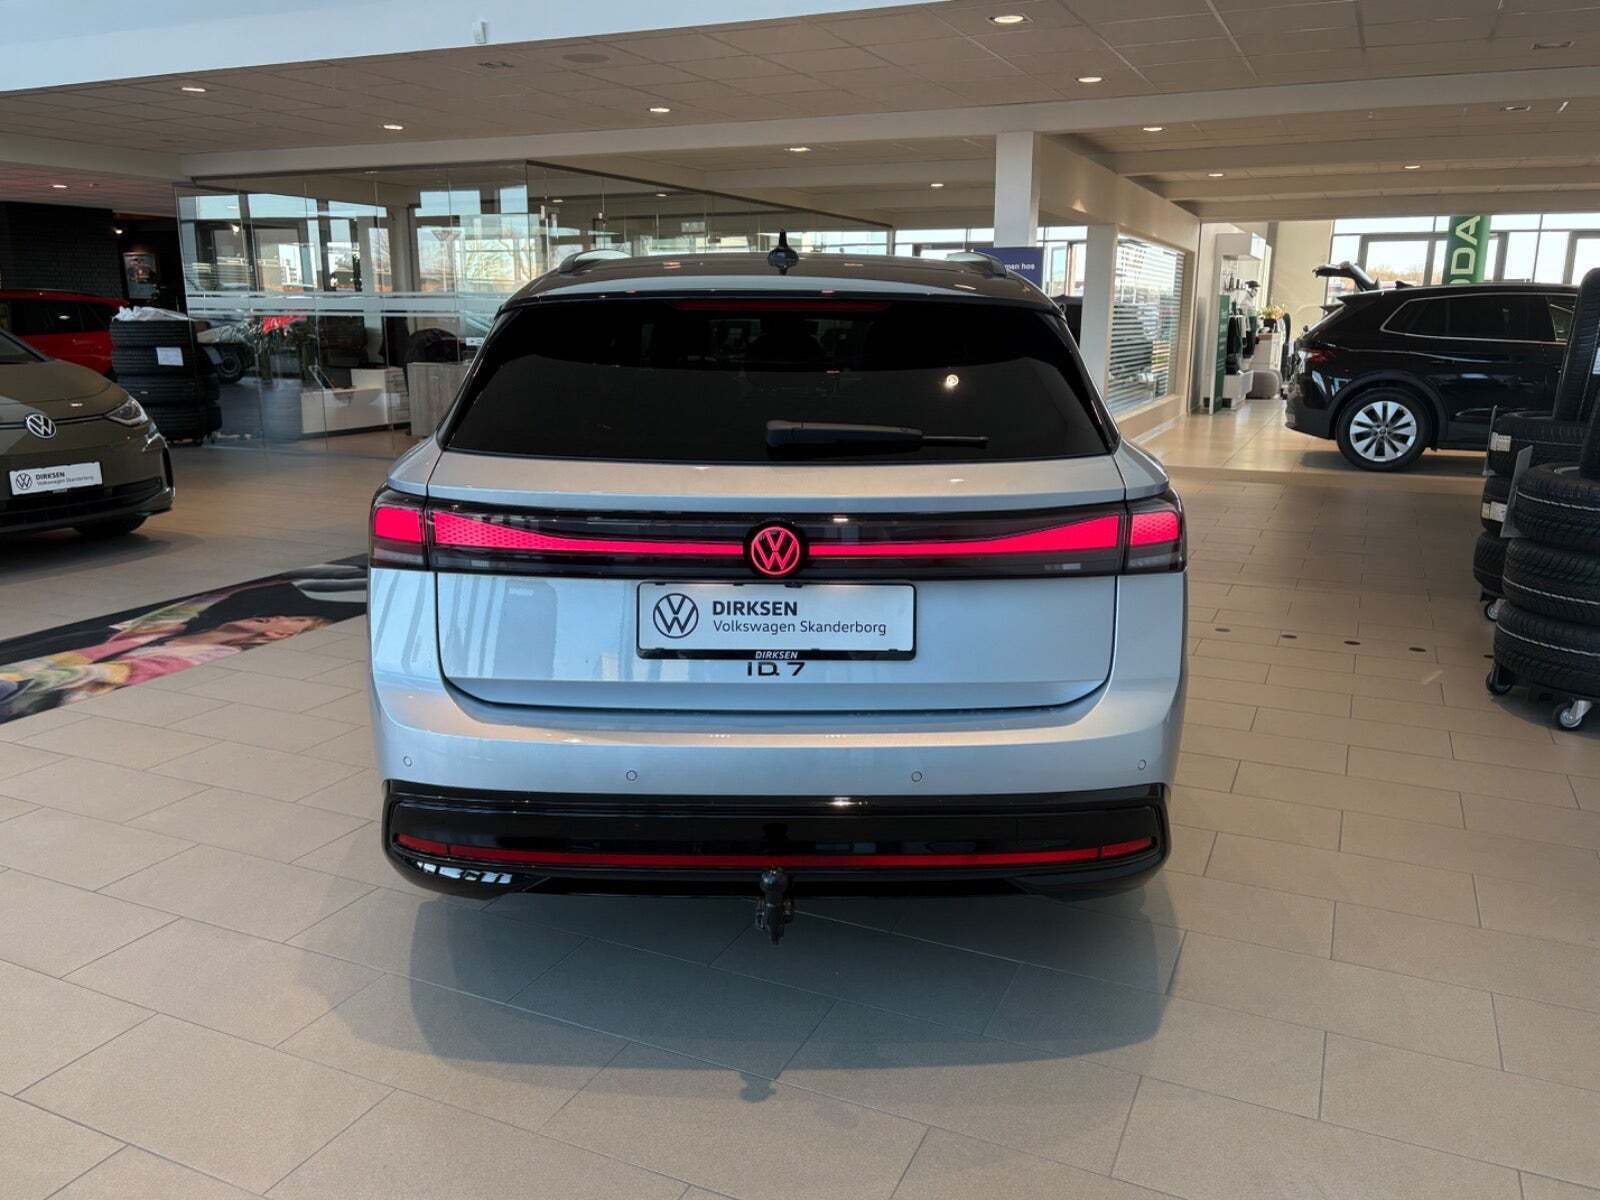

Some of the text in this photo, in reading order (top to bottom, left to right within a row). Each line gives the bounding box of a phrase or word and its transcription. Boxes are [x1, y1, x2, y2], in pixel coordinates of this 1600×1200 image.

[36, 471, 66, 480] DIRKSEN
[712, 600, 798, 617] DIRKSEN
[713, 619, 887, 637] Volkswagen Skanderborg
[755, 650, 799, 660] DIRKSEN
